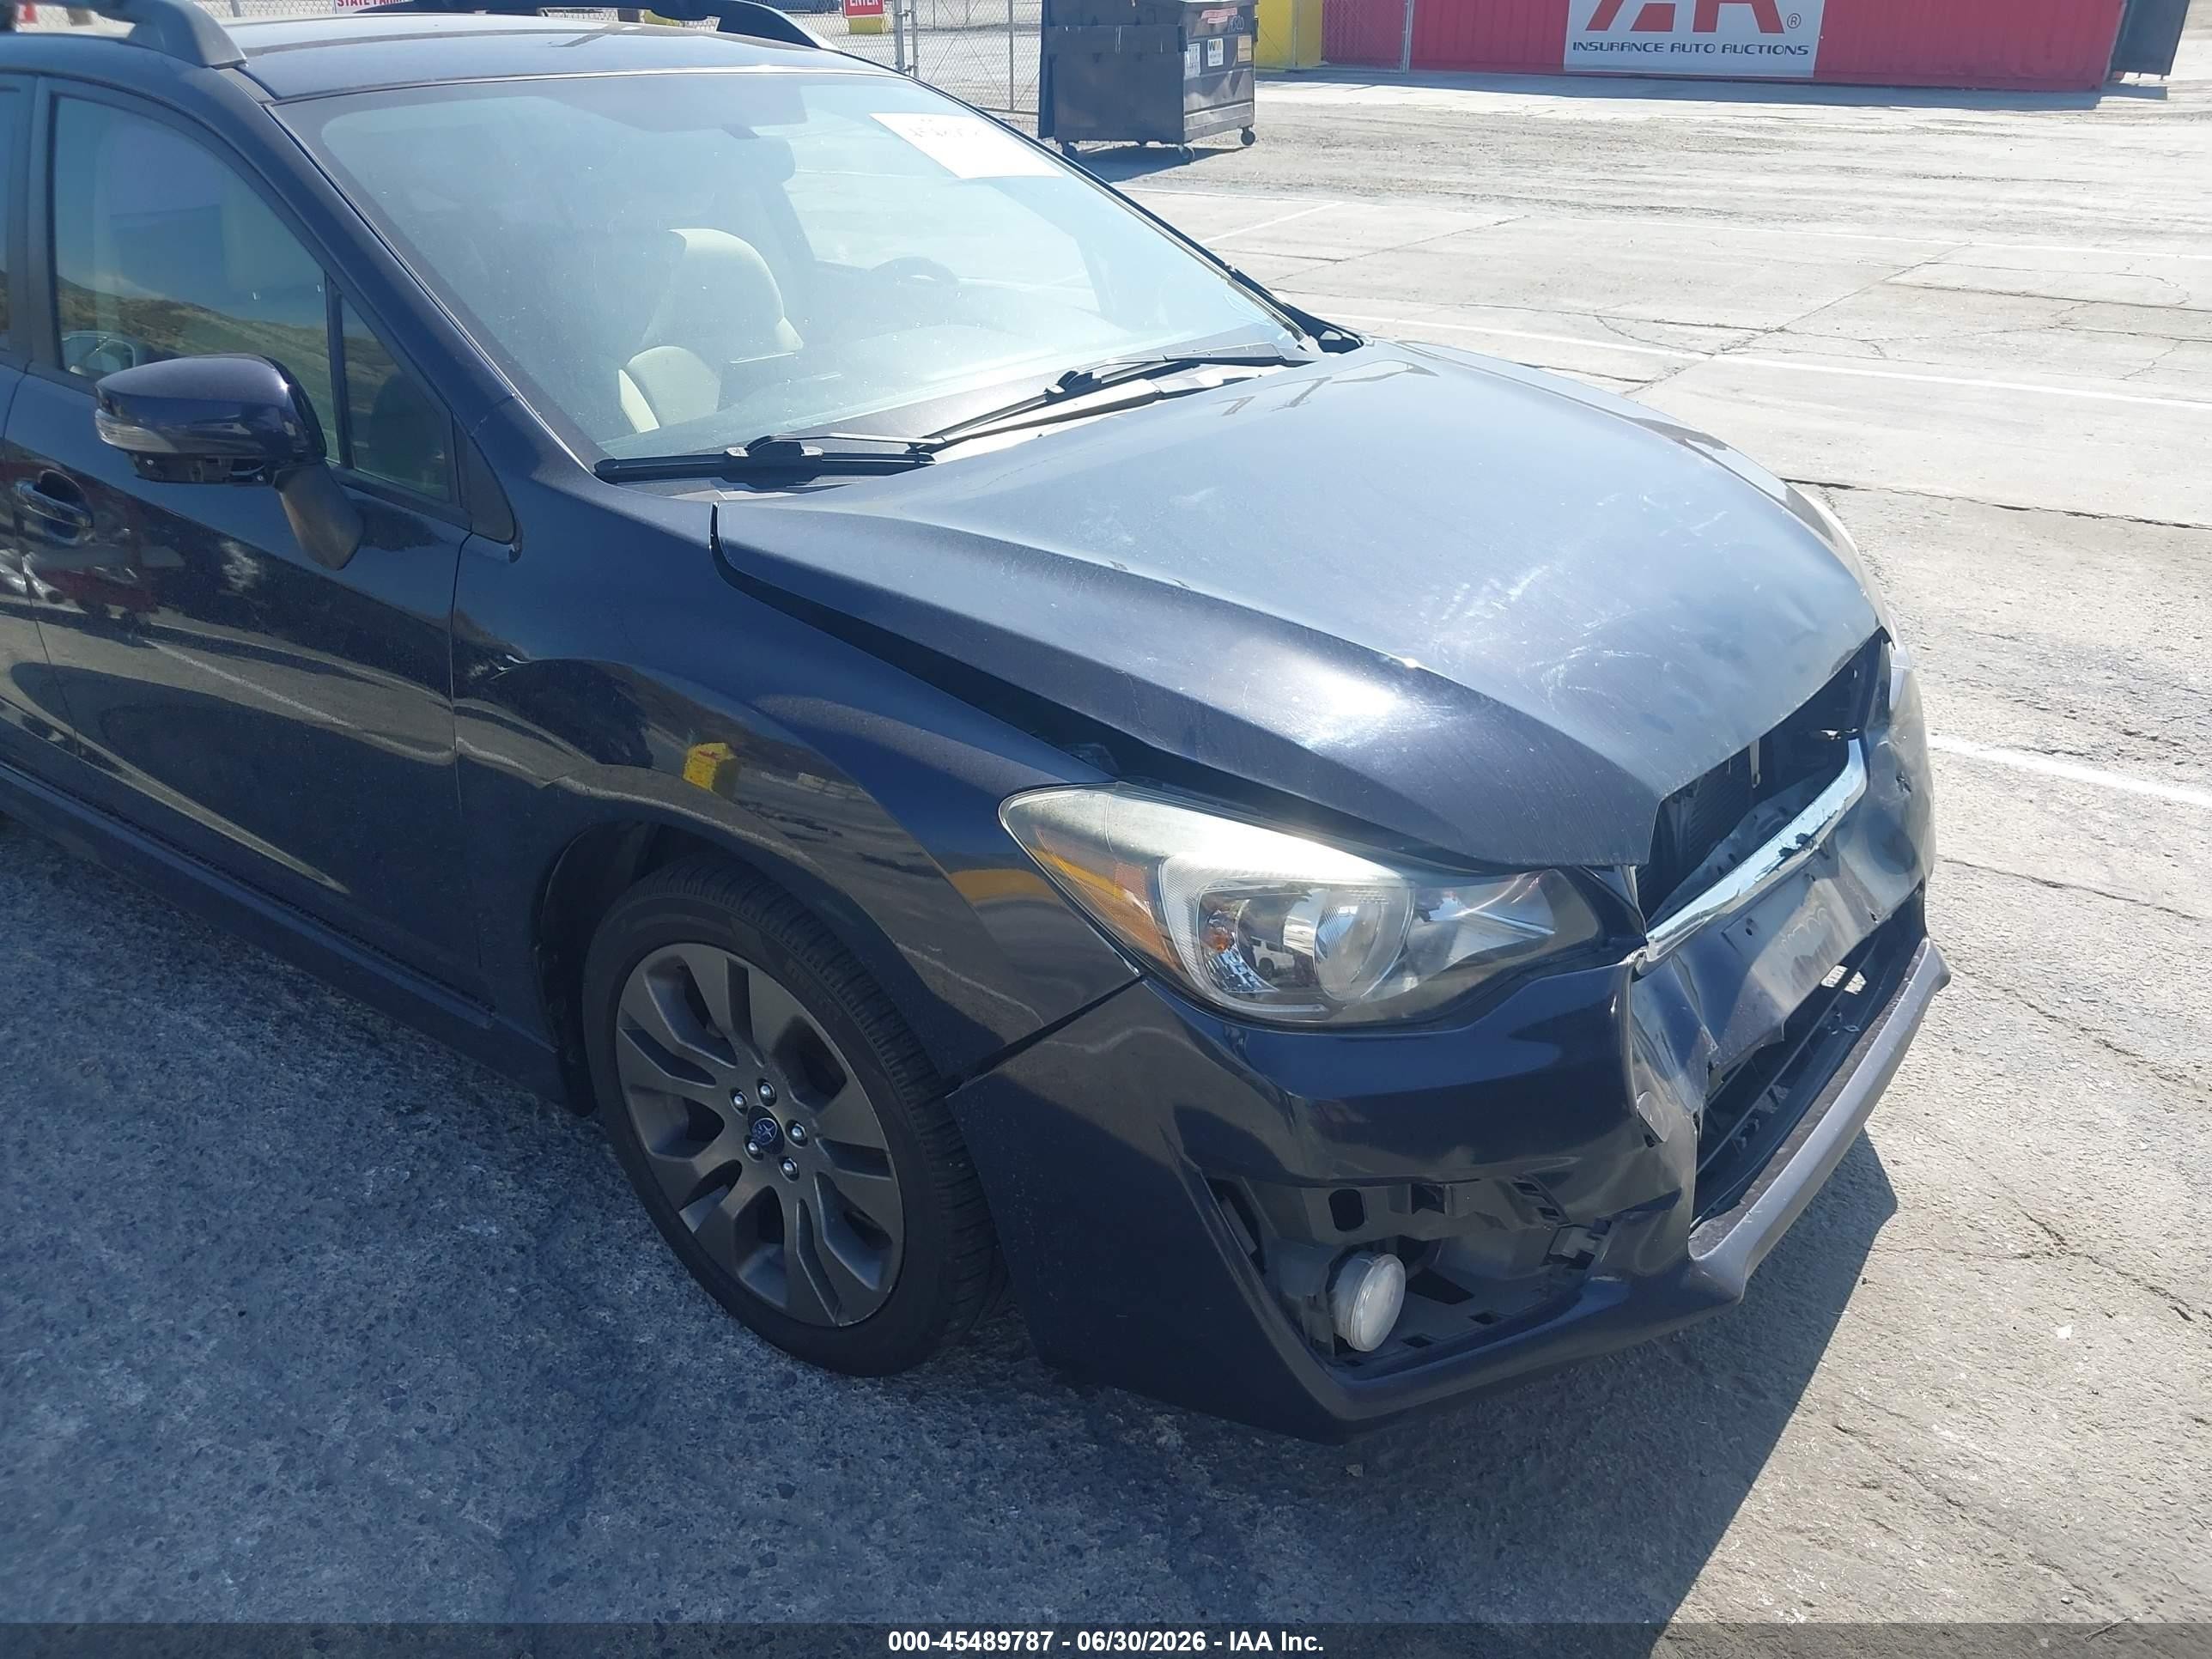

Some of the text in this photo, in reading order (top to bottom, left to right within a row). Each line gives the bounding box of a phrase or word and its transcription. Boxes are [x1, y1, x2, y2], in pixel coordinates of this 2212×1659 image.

[1572, 41, 1809, 56] INSURANCE AUTO AUCTIONS
